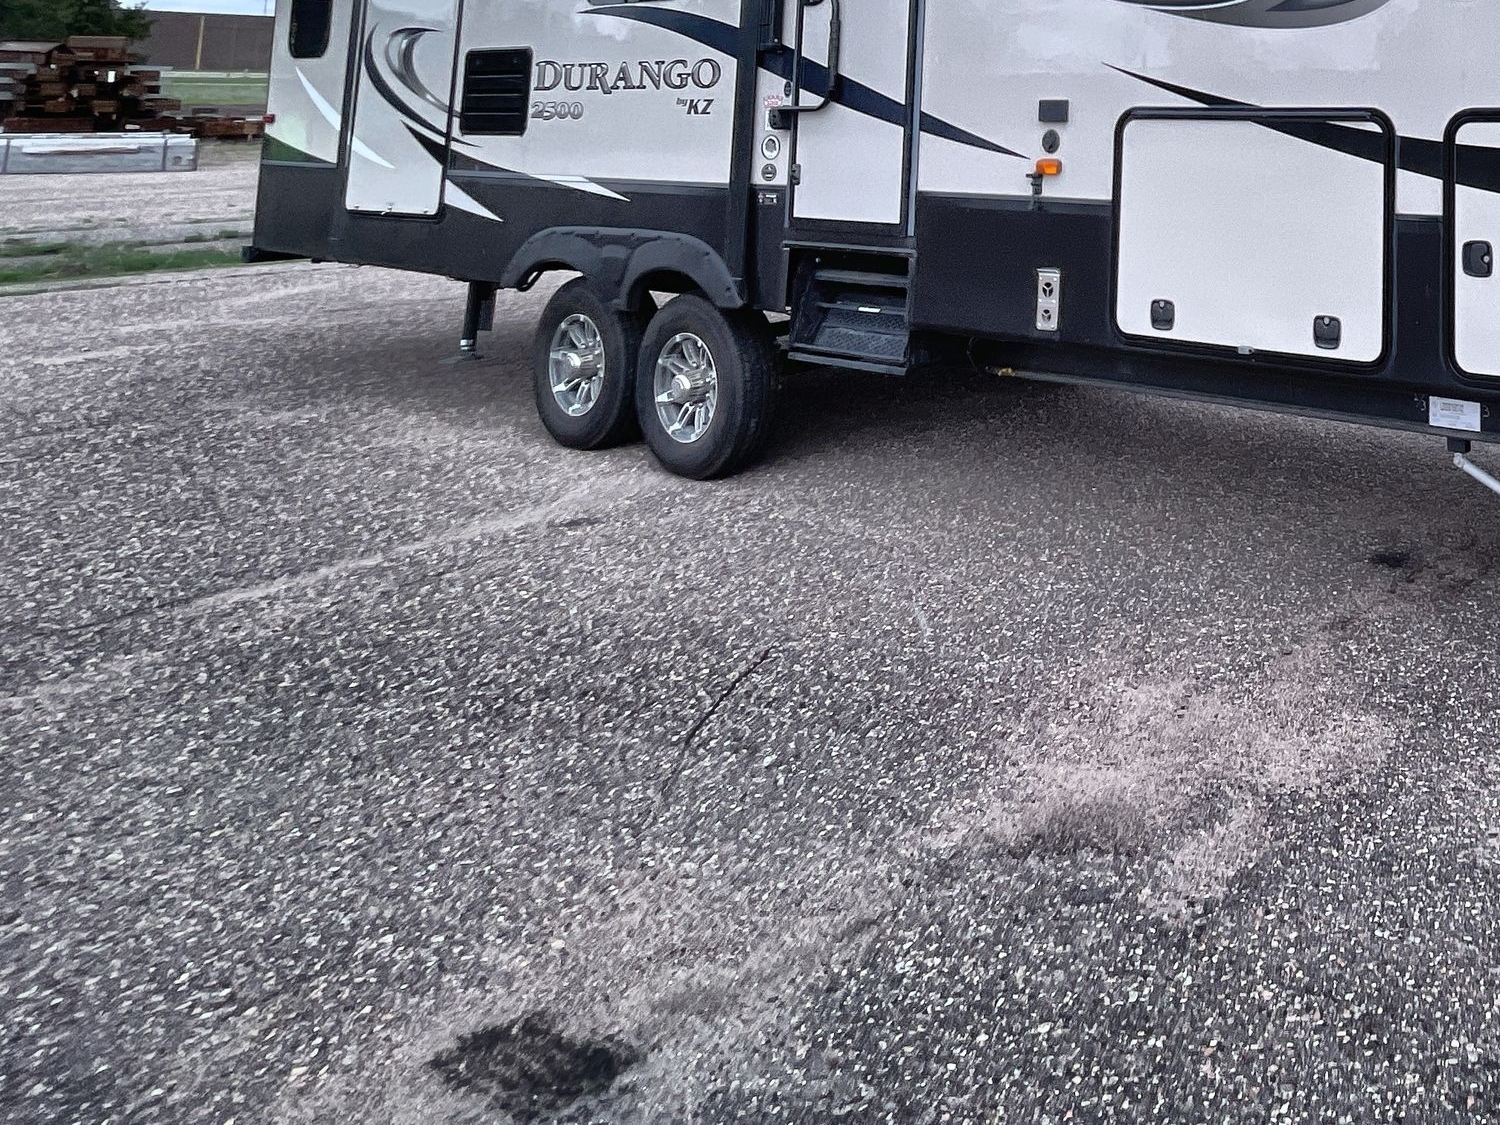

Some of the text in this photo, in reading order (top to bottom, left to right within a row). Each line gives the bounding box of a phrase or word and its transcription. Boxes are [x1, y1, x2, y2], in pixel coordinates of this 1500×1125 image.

[533, 58, 722, 95] DURANGO
[530, 101, 584, 121] 2500
[676, 96, 714, 115] by KZ
